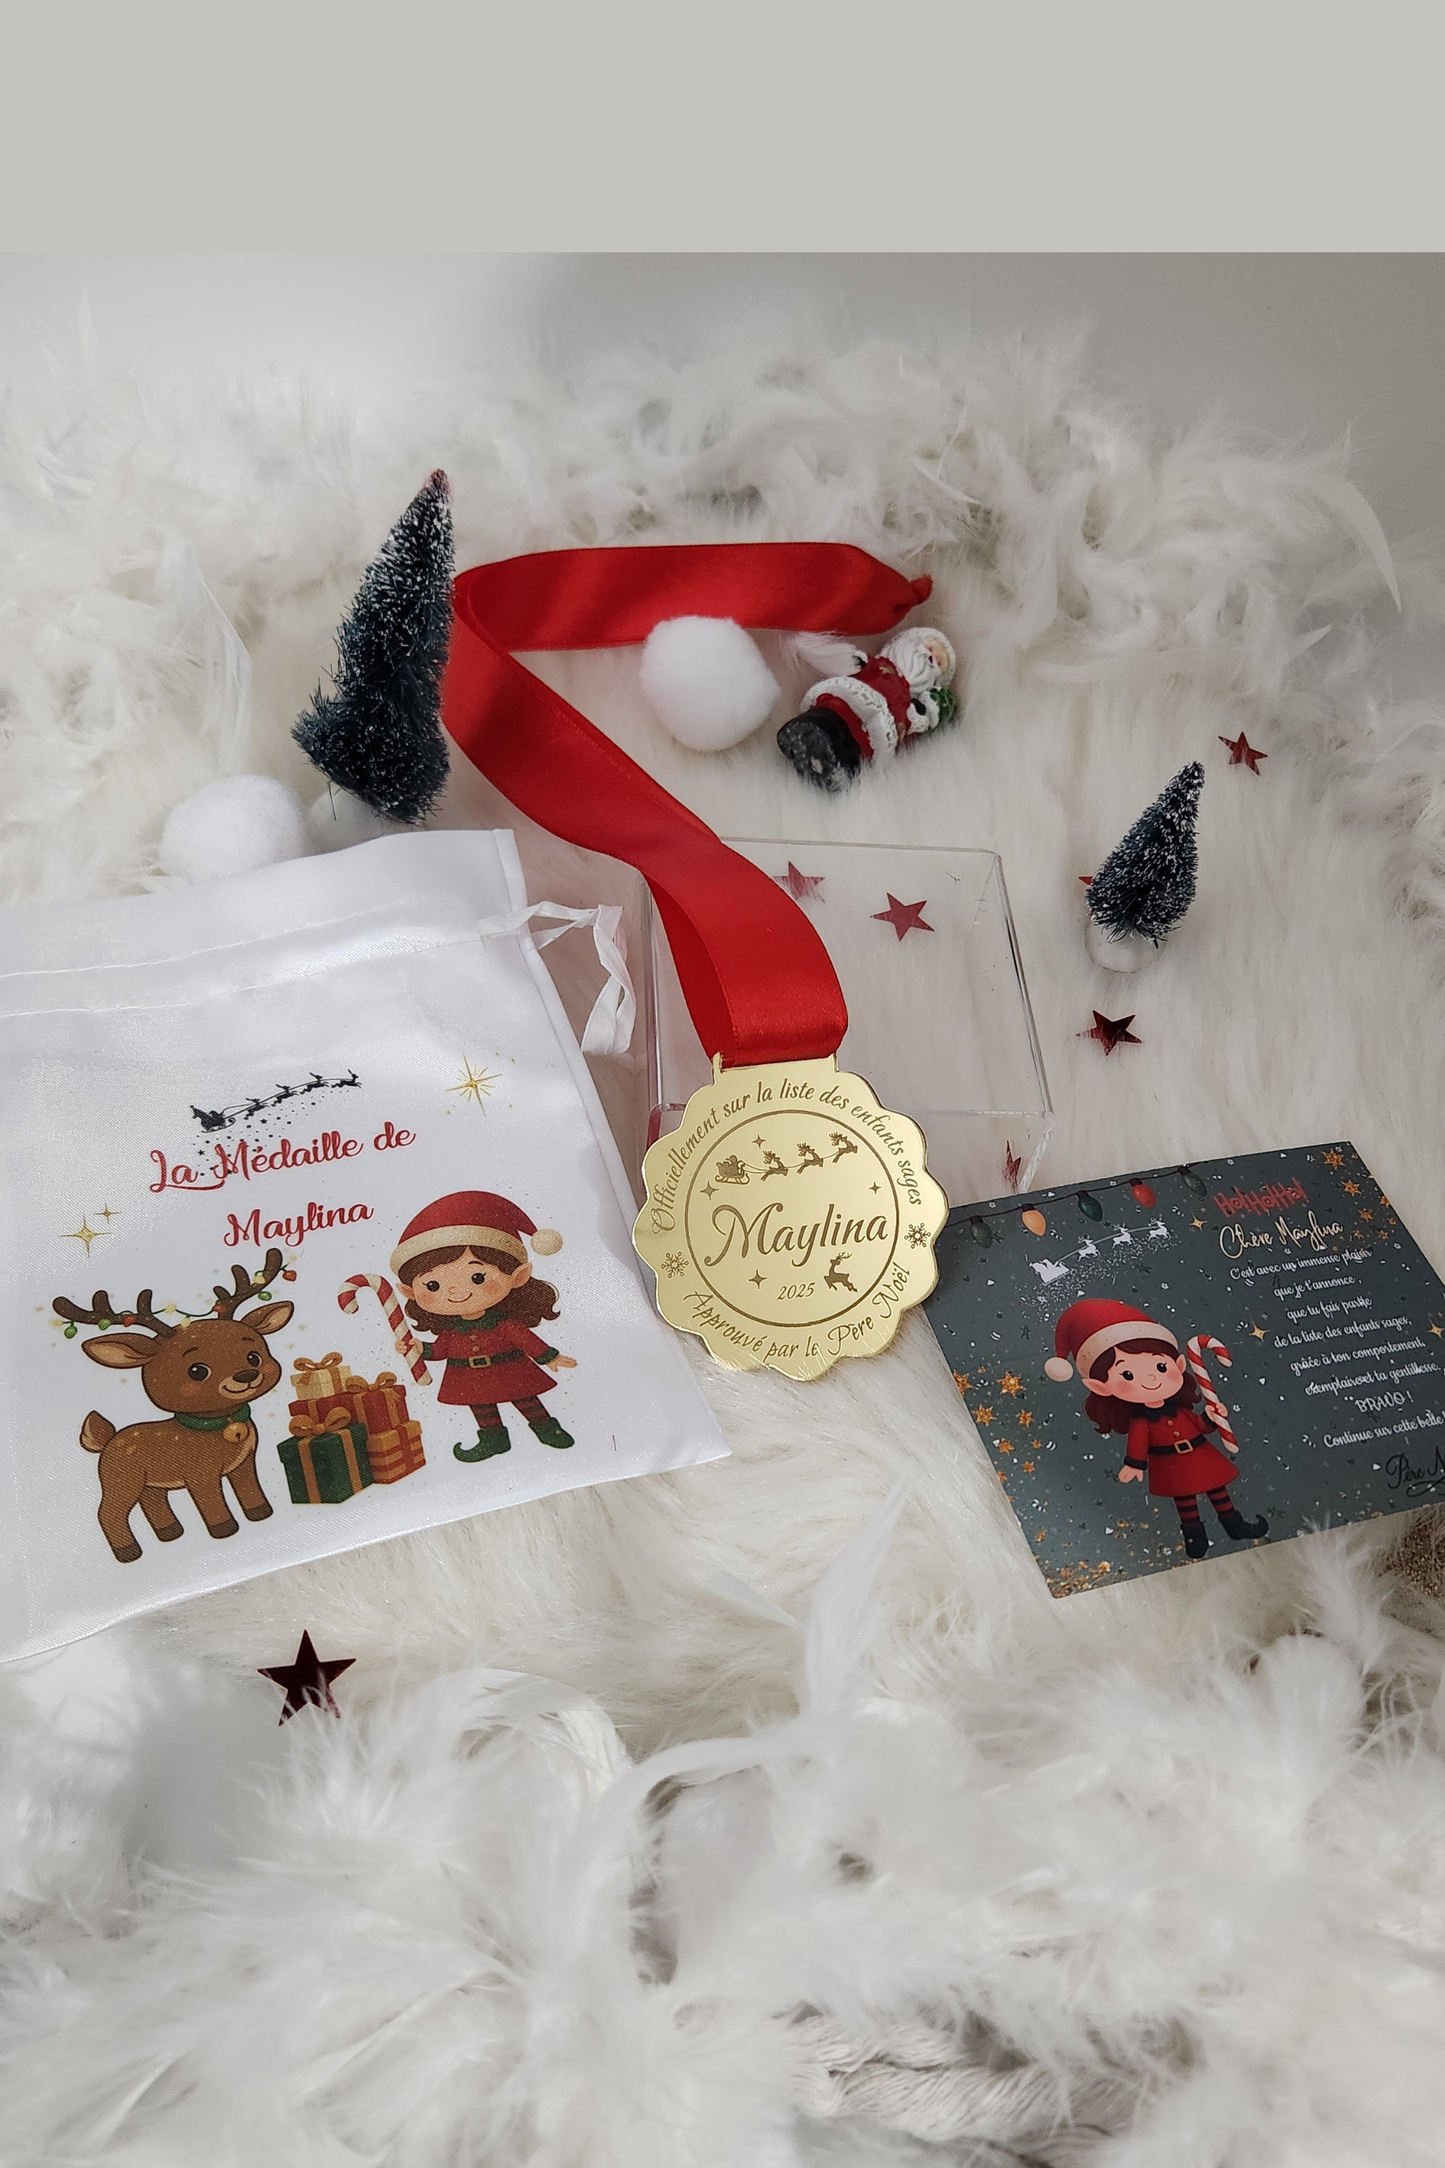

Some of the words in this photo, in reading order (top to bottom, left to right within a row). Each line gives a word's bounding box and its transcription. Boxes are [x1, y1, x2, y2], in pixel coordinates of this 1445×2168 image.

[149, 1149, 225, 1193] La
[213, 1131, 363, 1181] Médaille
[373, 1121, 416, 1150] de
[651, 1108, 721, 1235] Officiellement
[723, 1092, 750, 1117] sur
[757, 1082, 772, 1101] la
[779, 1079, 814, 1100] liste
[819, 1085, 849, 1109] des
[851, 1103, 904, 1156] enfants
[897, 1159, 922, 1206] sages
[224, 1202, 374, 1247] Maylina
[703, 1202, 889, 1267] Maylina
[1220, 1223, 1273, 1259] Chère
[1274, 1210, 1343, 1251] Maylina
[1230, 1269, 1255, 1280] C'est
[1256, 1265, 1281, 1275] avec
[1282, 1262, 1297, 1271] un
[1298, 1255, 1341, 1269] immense
[1341, 1250, 1373, 1265] plaisir
[776, 1282, 815, 1300] 2025
[1274, 1288, 1294, 1301] que
[1294, 1283, 1305, 1299] je
[683, 1290, 768, 1352] Approuvé
[765, 1342, 799, 1360] par
[805, 1337, 819, 1357] le
[827, 1317, 874, 1356] Père
[871, 1262, 910, 1319] Noël
[1287, 1308, 1307, 1323] que
[1308, 1305, 1320, 1315] tu
[1320, 1300, 1341, 1319] fais
[1274, 1336, 1288, 1348] de
[1288, 1333, 1301, 1345] la
[1301, 1330, 1324, 1343] liste
[1325, 1325, 1343, 1338] des
[1344, 1320, 1380, 1337] enfants
[1322, 1354, 1331, 1364] à
[1331, 1350, 1351, 1363] ton
[1374, 1370, 1388, 1381] ta
[1355, 1392, 1406, 1412] BRAVO
[1323, 1430, 1374, 1447] Continue
[1374, 1424, 1392, 1435] sur
[1393, 1420, 1418, 1433] cette
[1417, 1410, 1444, 1428] belle
